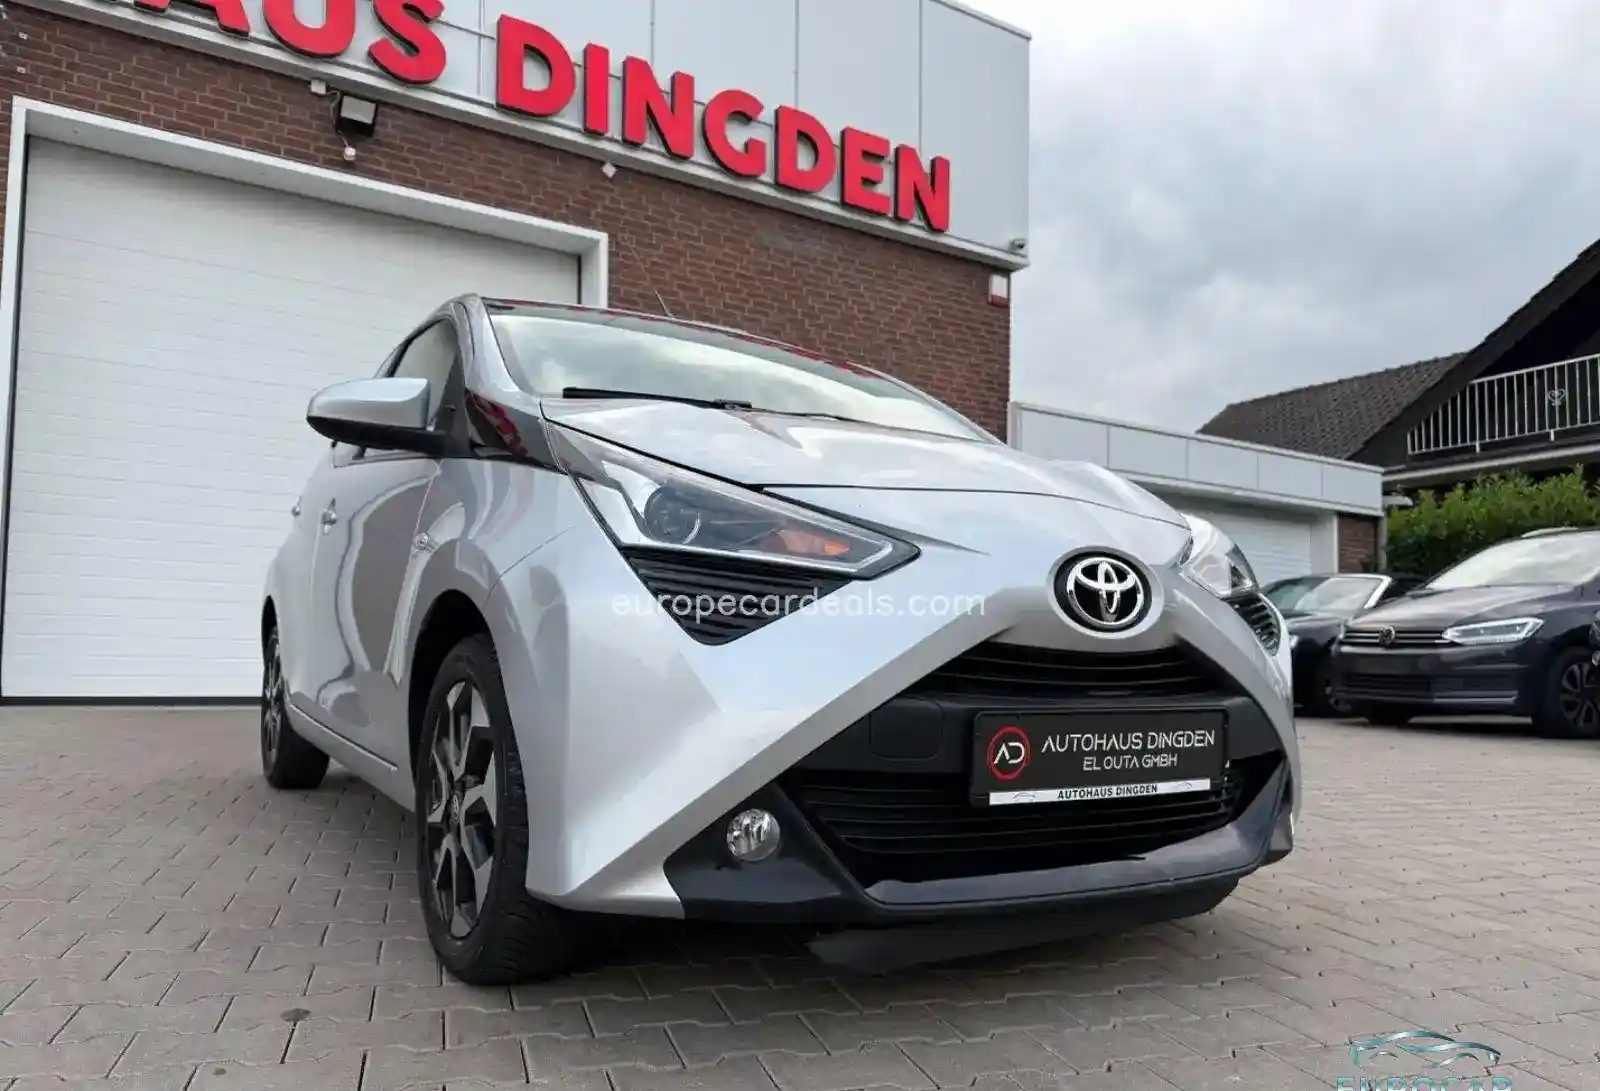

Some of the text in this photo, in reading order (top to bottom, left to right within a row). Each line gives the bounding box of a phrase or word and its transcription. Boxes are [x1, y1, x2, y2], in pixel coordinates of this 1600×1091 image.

[496, 14, 950, 232] DINGDEN
[1041, 729, 1215, 753] AUTOHAUS DINGDEN
[1083, 753, 1178, 771] EL OUTA GMBH
[1057, 784, 1158, 800] AUTOHAUS DINGDEN
